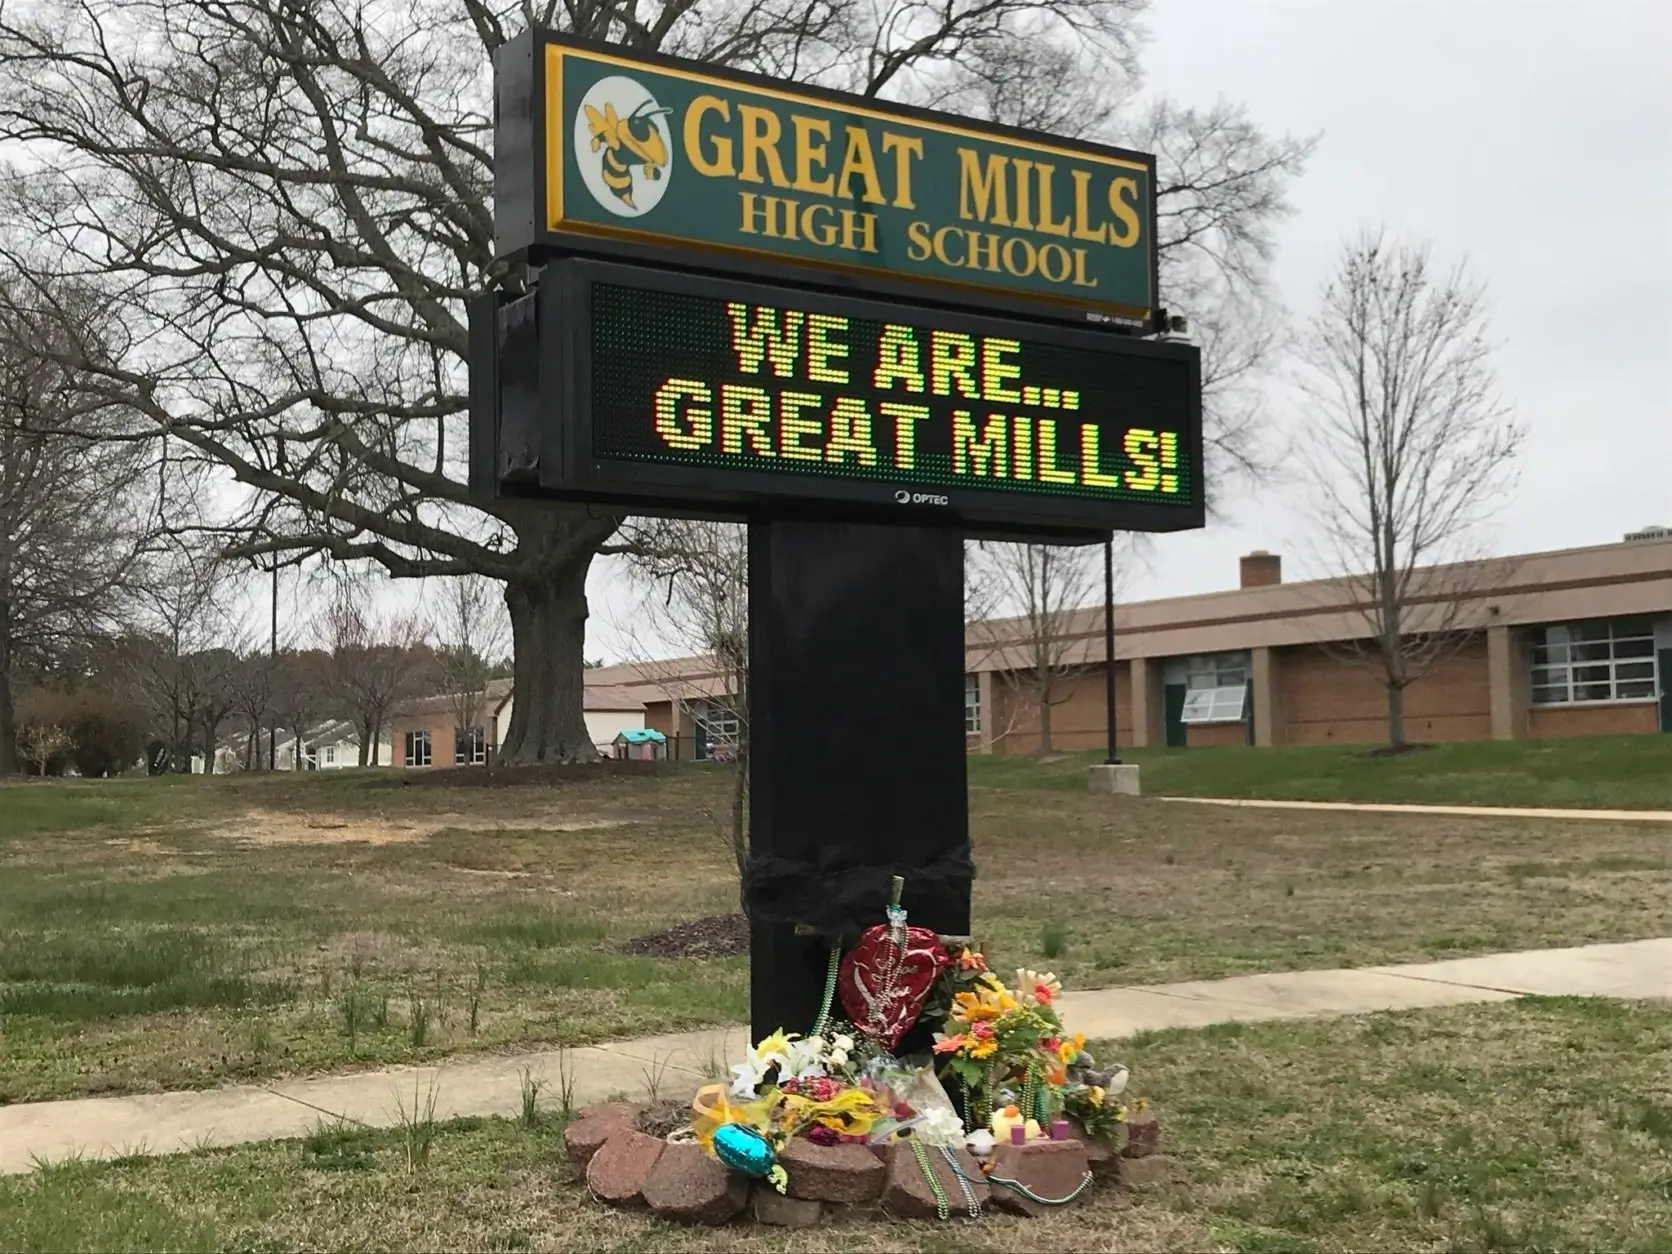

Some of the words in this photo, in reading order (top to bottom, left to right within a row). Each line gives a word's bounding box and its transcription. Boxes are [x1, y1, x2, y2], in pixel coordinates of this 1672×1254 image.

[683, 95, 924, 210] GREAT
[957, 147, 1140, 248] MILLS
[738, 191, 879, 254] HIGH
[907, 221, 1098, 287] SCHOOL
[727, 302, 849, 384] WE
[873, 324, 1079, 410] ARE...
[654, 377, 930, 469] GREAT
[952, 410, 1178, 493] MILLS!
[913, 493, 948, 505] OPTEC
